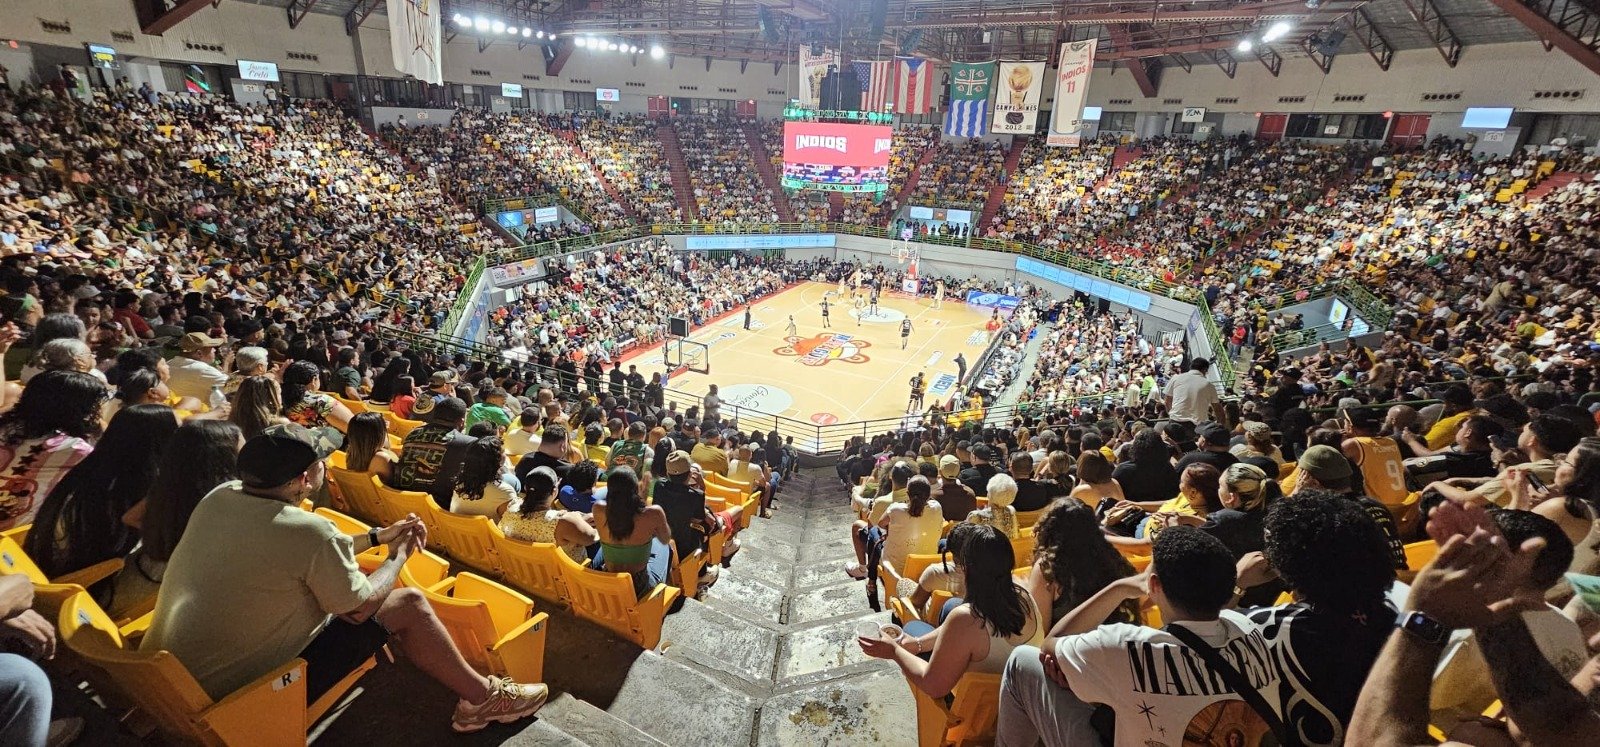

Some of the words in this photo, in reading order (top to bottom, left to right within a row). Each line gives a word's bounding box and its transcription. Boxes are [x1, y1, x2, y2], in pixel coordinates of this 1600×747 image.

[1061, 65, 1087, 81] INDIOS
[1066, 81, 1076, 93] 11
[795, 134, 847, 153] INDIOS
[1386, 460, 1403, 491] 9
[282, 672, 292, 687] R
